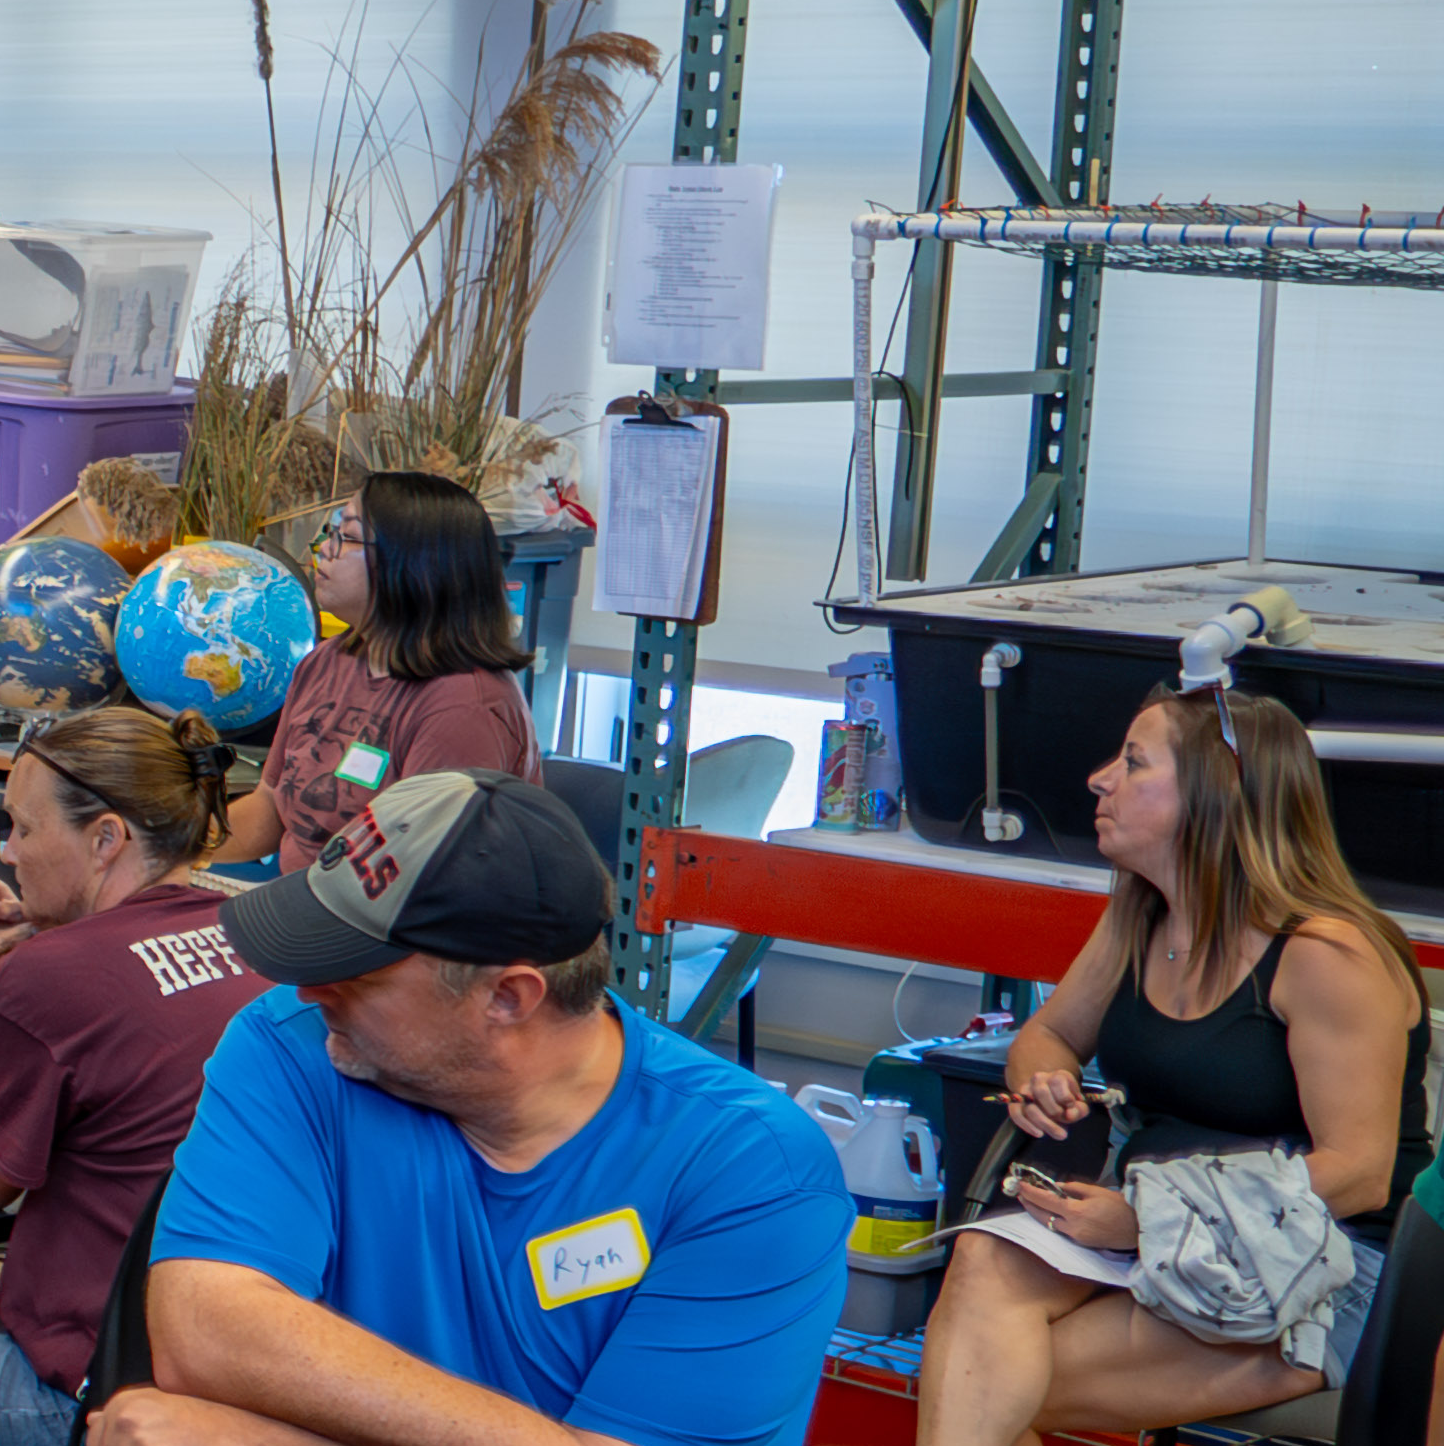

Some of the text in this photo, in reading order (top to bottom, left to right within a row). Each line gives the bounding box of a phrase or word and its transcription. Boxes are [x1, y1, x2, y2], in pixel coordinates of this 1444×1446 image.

[858, 429, 871, 470] ASTM
[128, 923, 244, 997] HEFF
[553, 1245, 623, 1285] Ryan
